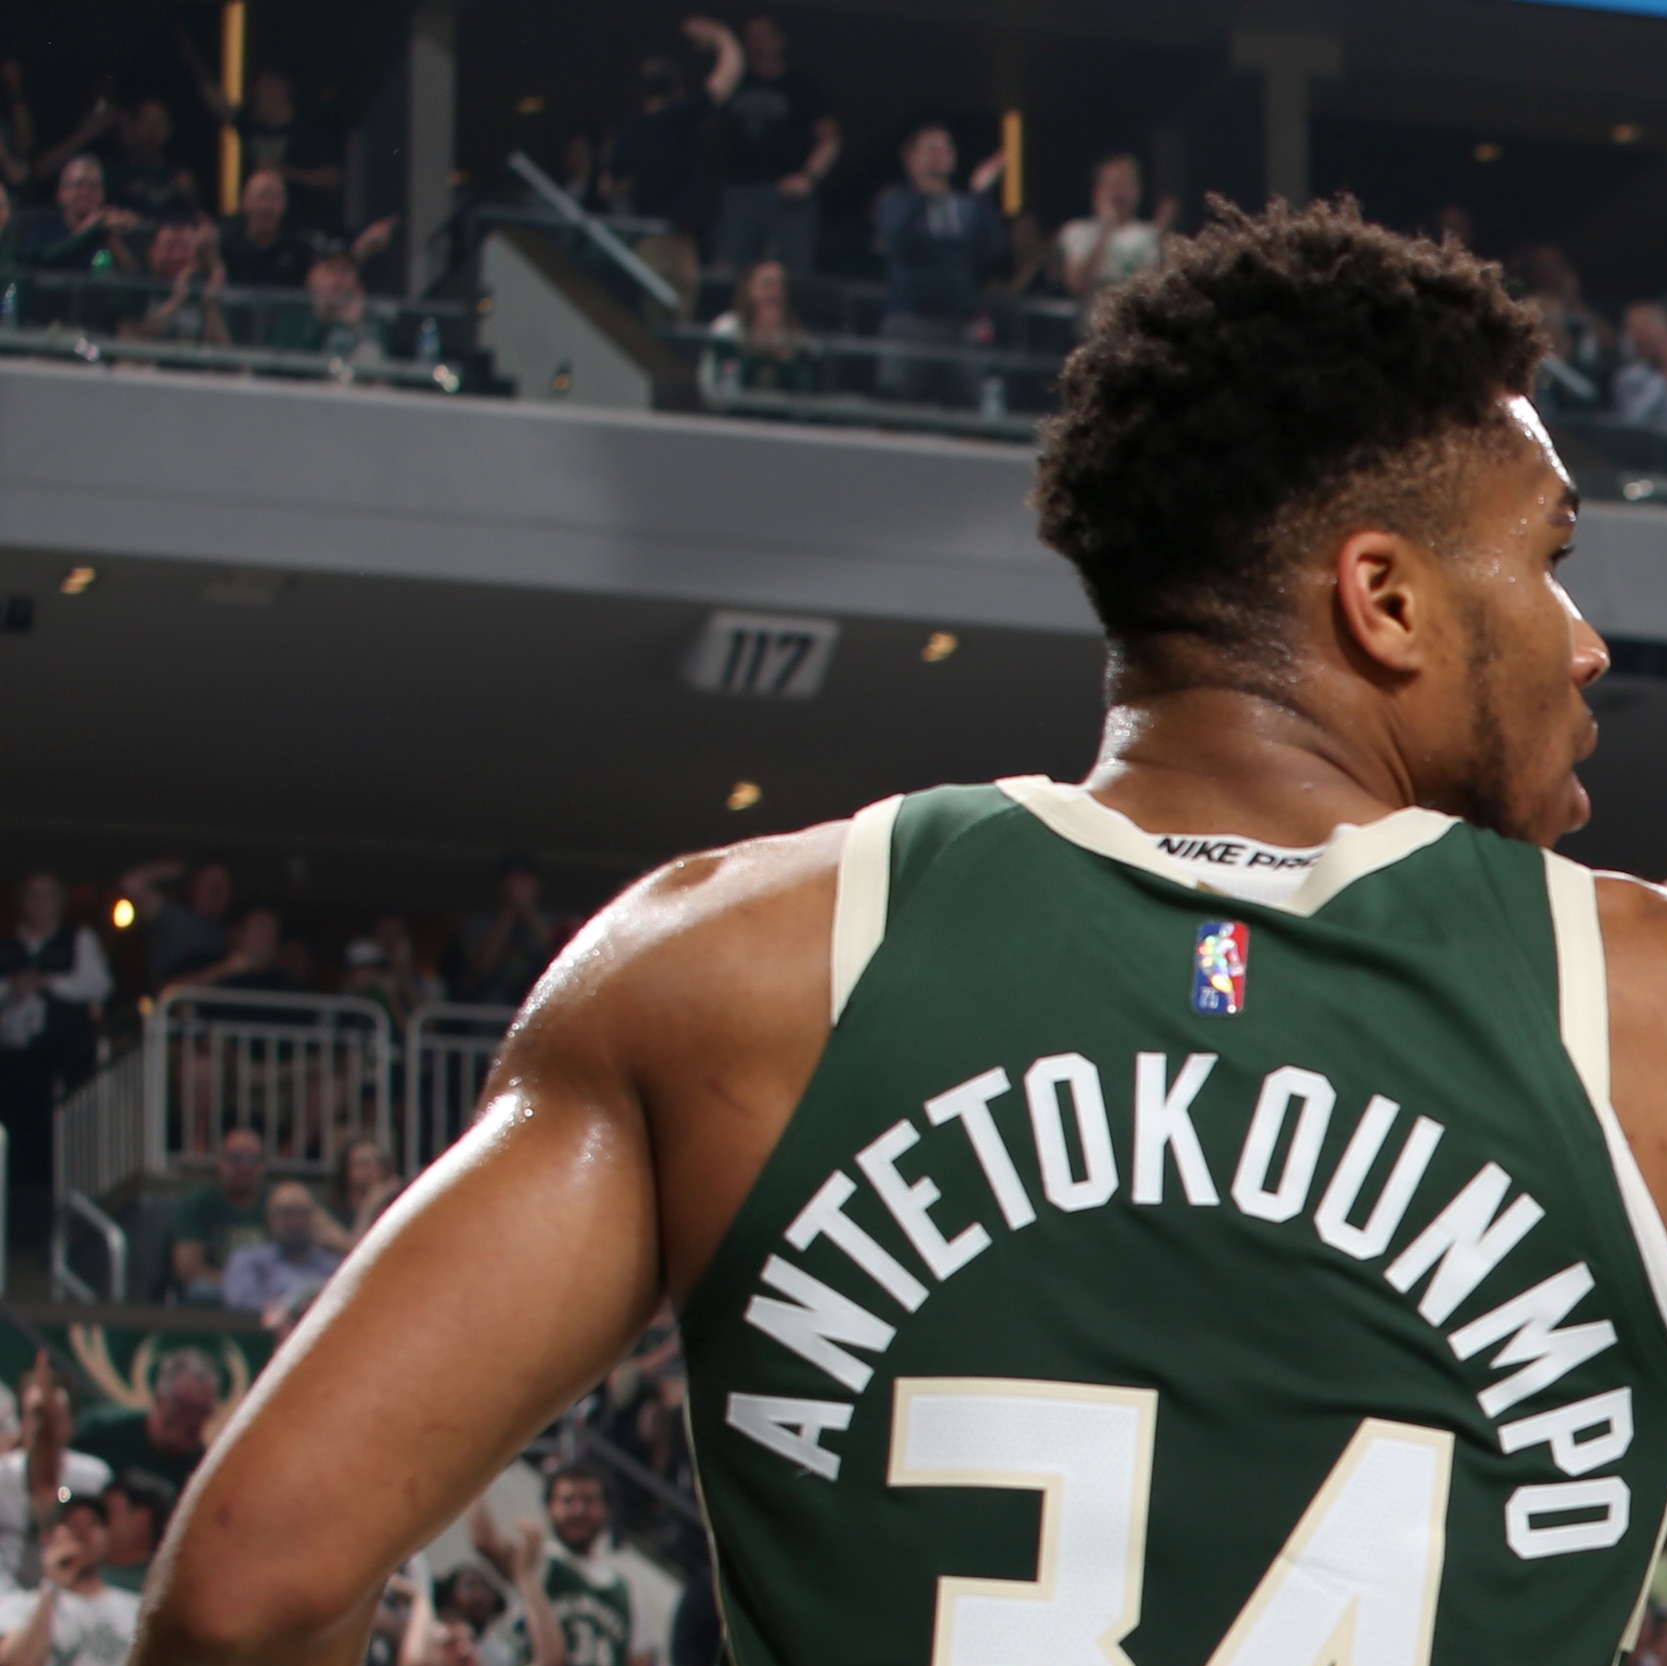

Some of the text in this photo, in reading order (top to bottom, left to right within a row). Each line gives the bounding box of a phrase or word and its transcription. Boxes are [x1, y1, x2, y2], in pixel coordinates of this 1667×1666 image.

[721, 628, 816, 692] 117
[1156, 835, 1246, 866] NIKE
[726, 1052, 1633, 1560] ANTETOKOUNMPO
